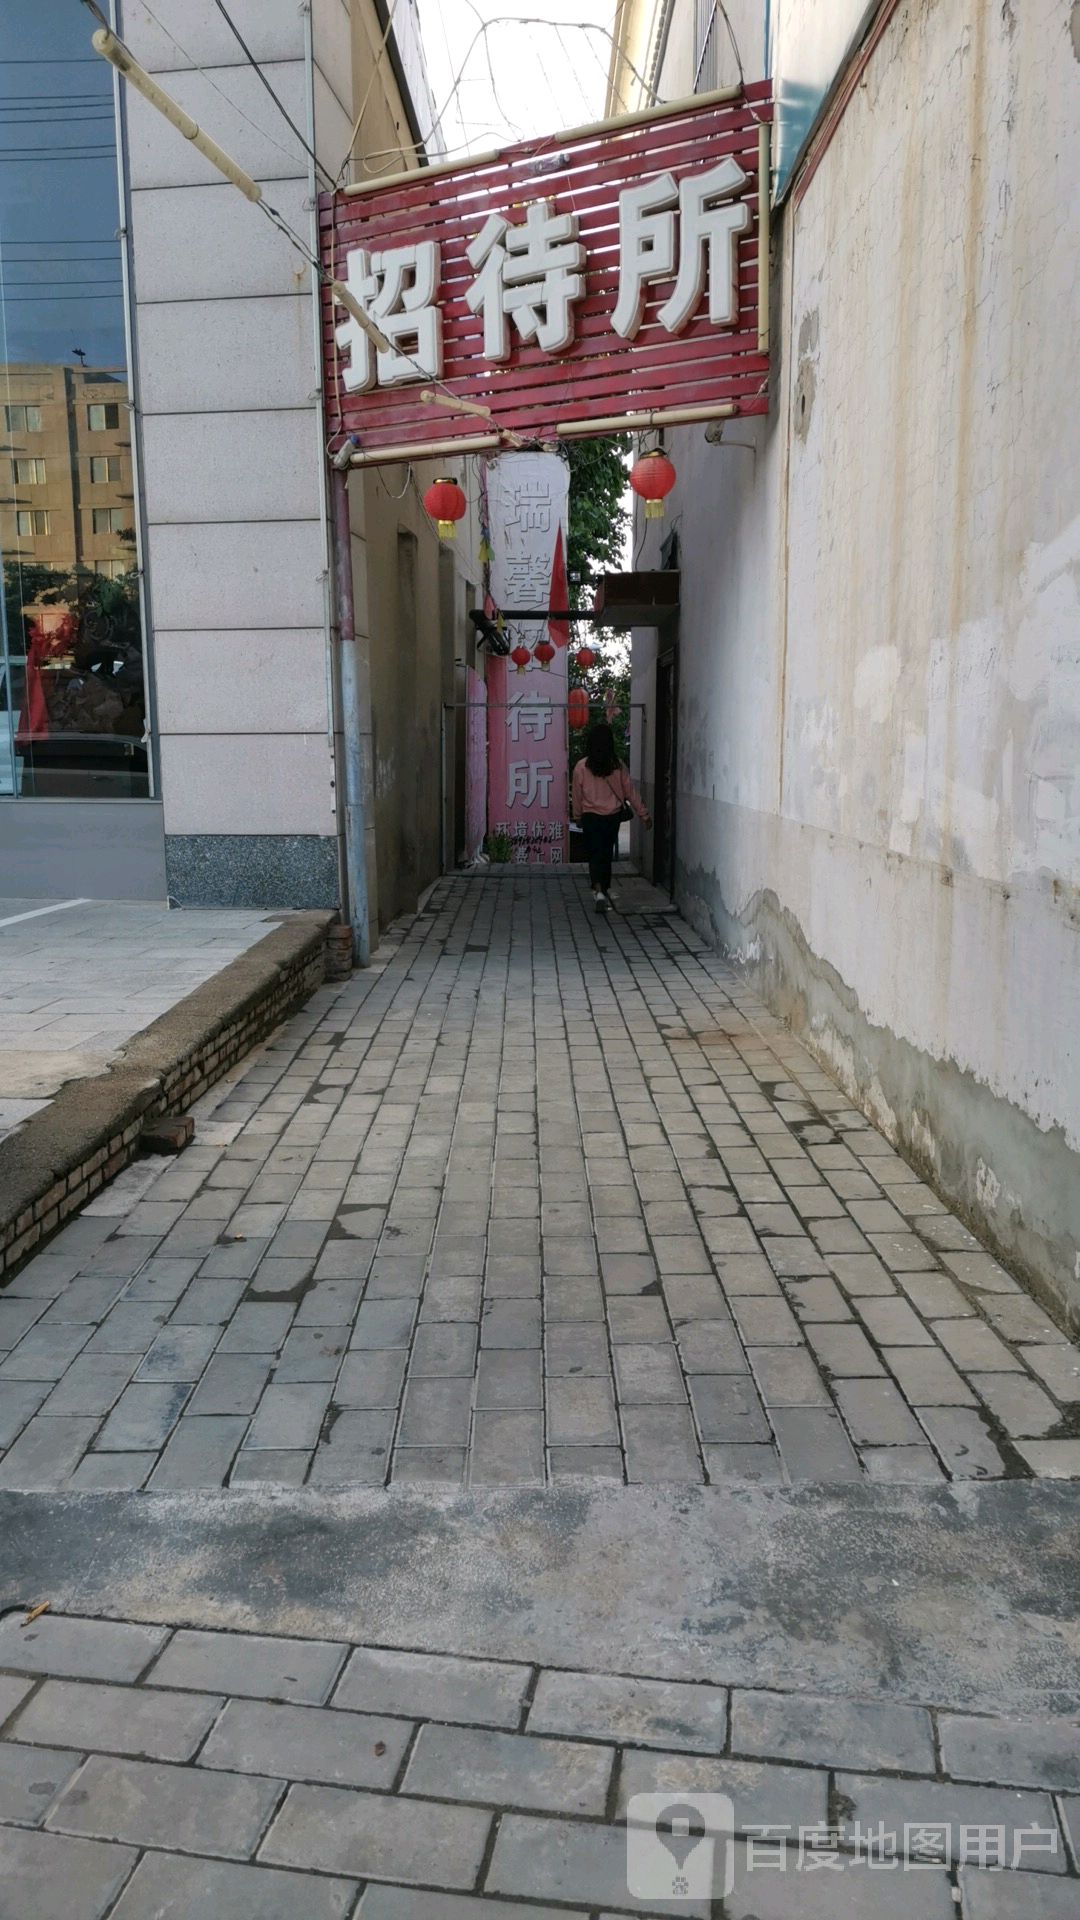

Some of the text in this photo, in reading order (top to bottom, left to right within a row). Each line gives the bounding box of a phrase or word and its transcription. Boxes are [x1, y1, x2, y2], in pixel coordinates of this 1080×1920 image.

[334, 155, 753, 393] 招待所
[495, 821, 564, 839] 环境优雅
[512, 848, 563, 865] 费上网
